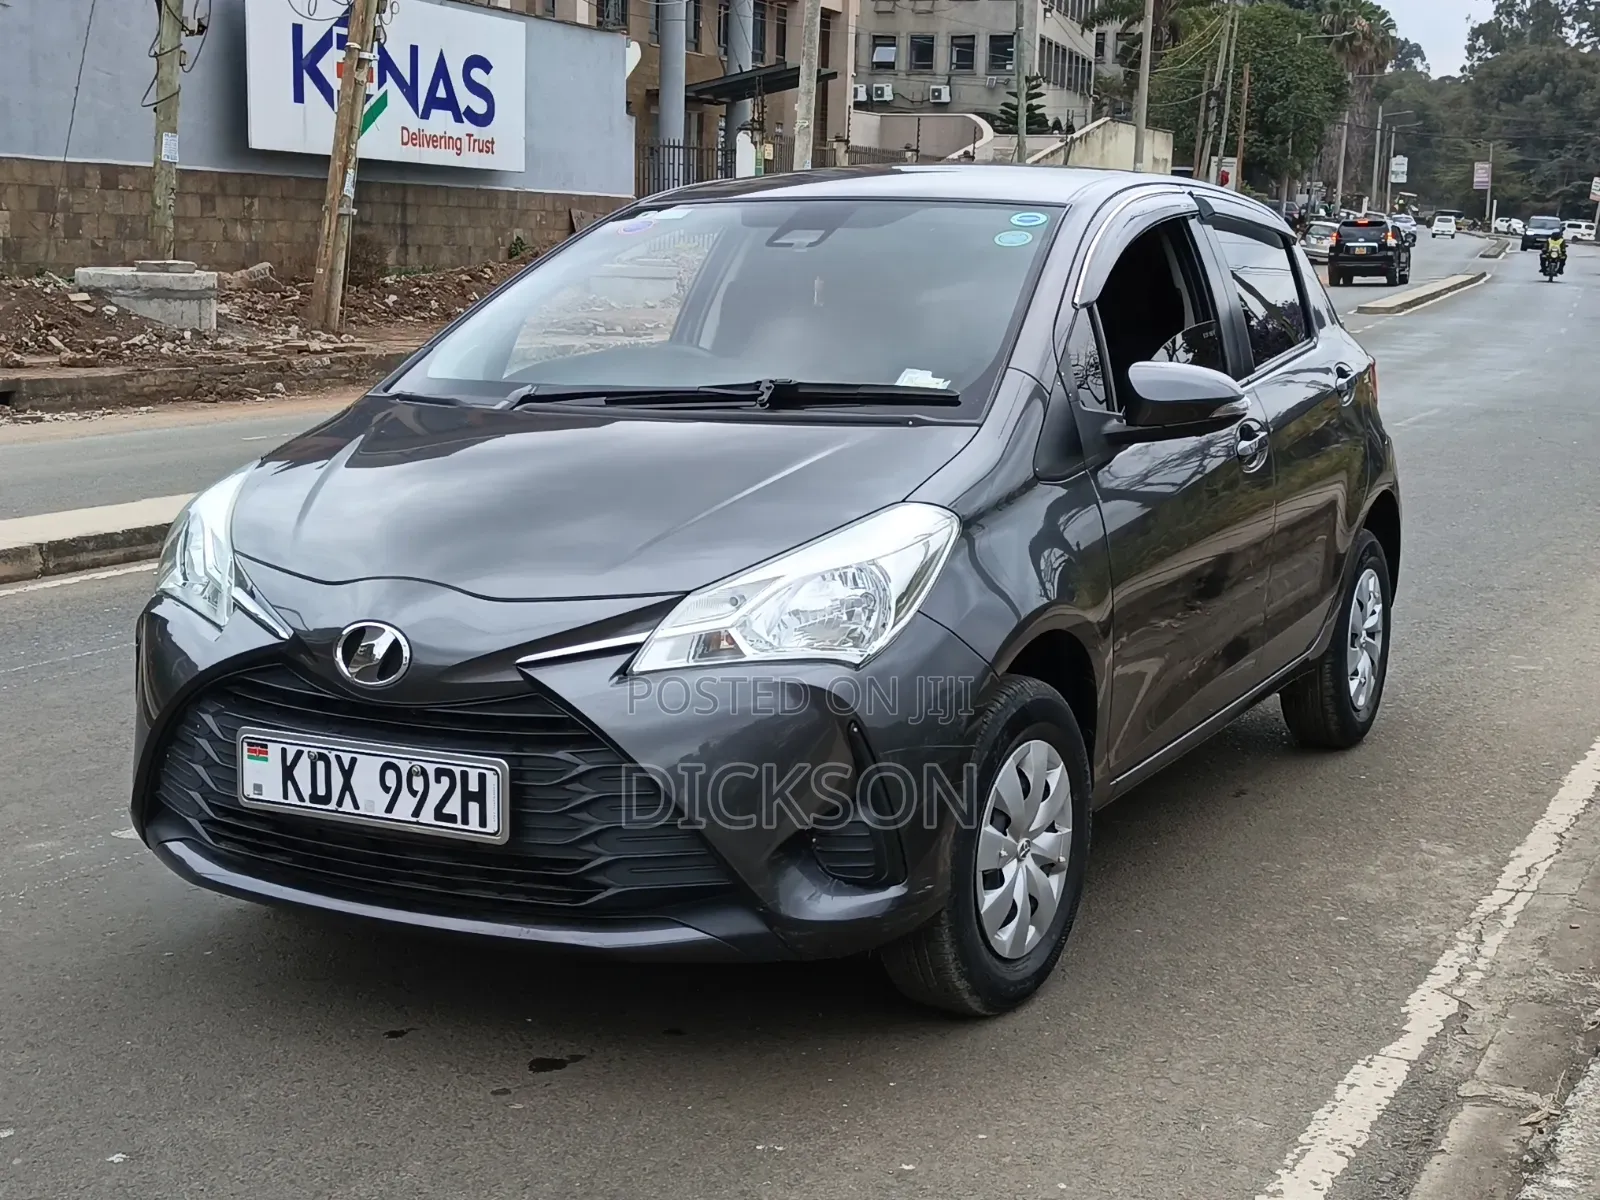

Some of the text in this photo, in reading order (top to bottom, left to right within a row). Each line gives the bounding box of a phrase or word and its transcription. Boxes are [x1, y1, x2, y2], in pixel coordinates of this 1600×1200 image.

[400, 126, 495, 156] Delivering Trust
[280, 746, 360, 811] KDX
[379, 761, 488, 829] 992H
